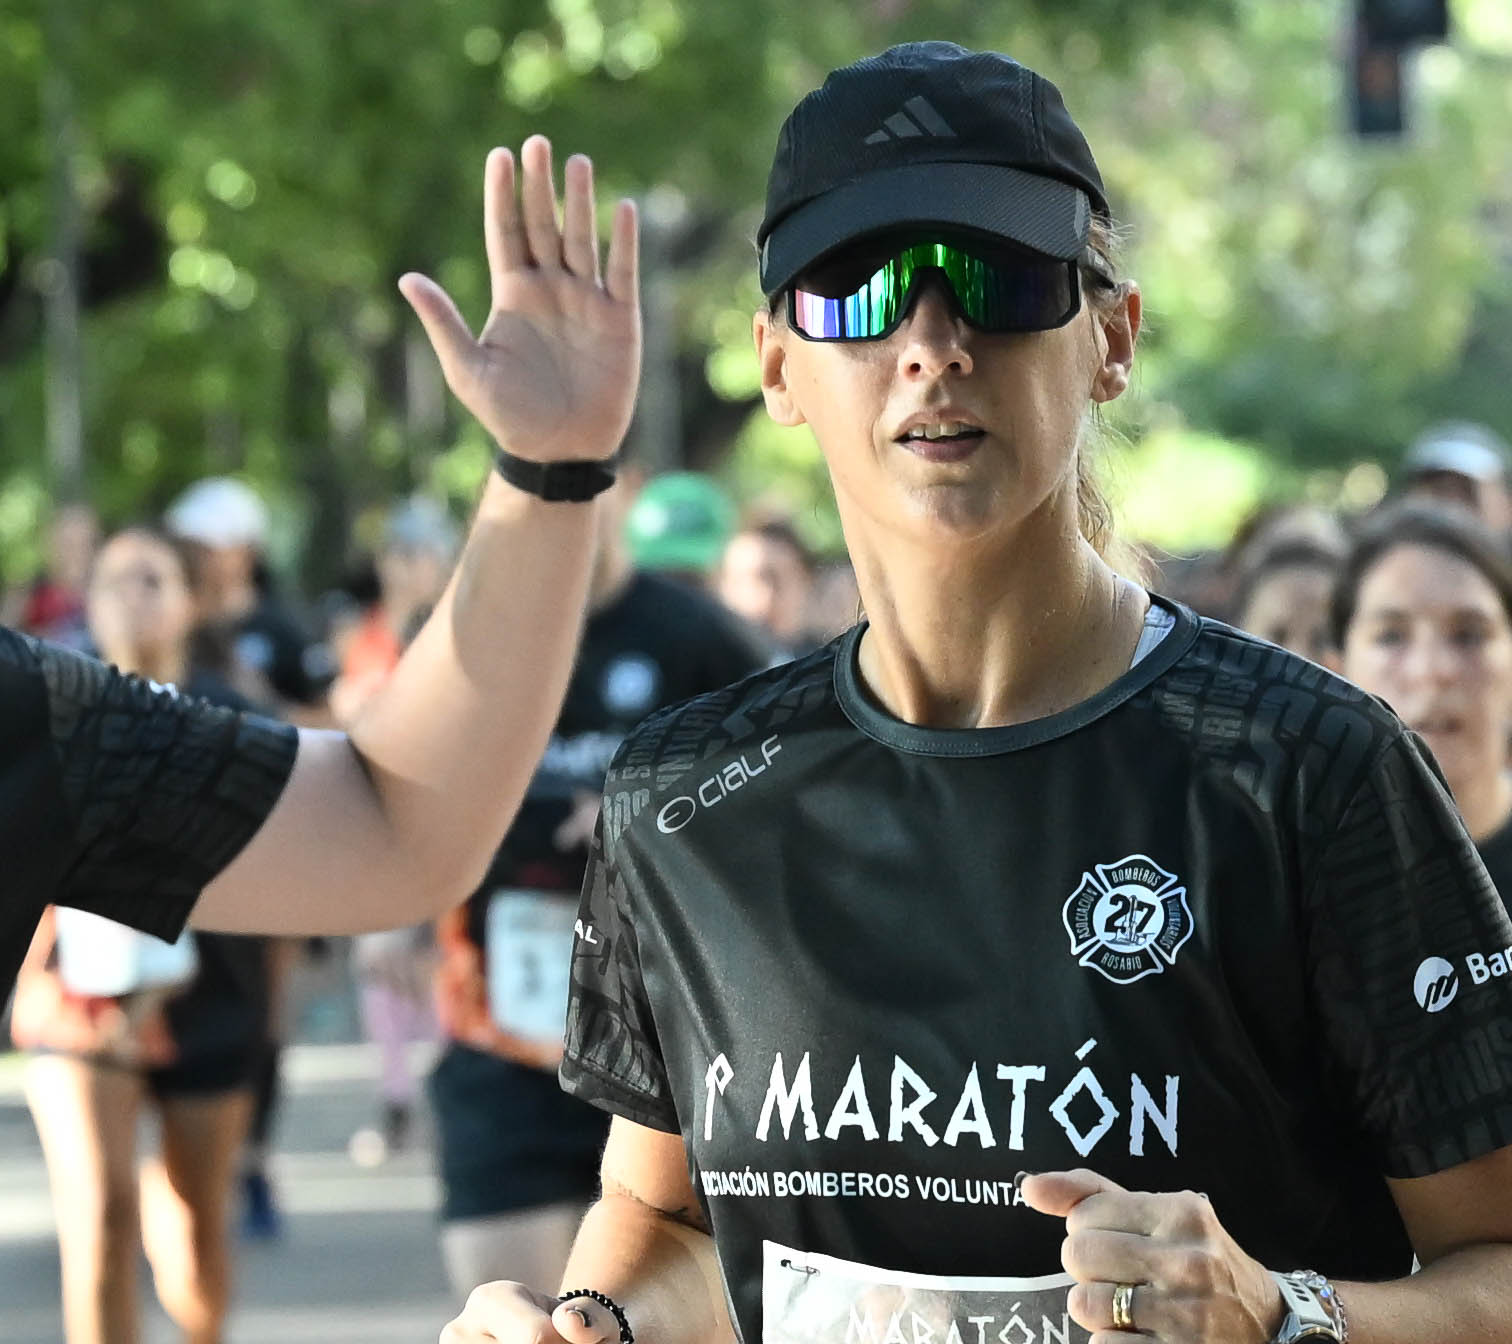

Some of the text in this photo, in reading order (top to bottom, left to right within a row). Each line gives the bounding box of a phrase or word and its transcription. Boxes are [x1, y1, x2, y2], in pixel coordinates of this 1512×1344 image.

[1111, 867, 1162, 887] BOMBEROS
[1104, 893, 1157, 934] 27
[1100, 952, 1143, 970] ROSARIO
[756, 1033, 1180, 1157] MARATÓN
[773, 1170, 910, 1199] BOMBEROS
